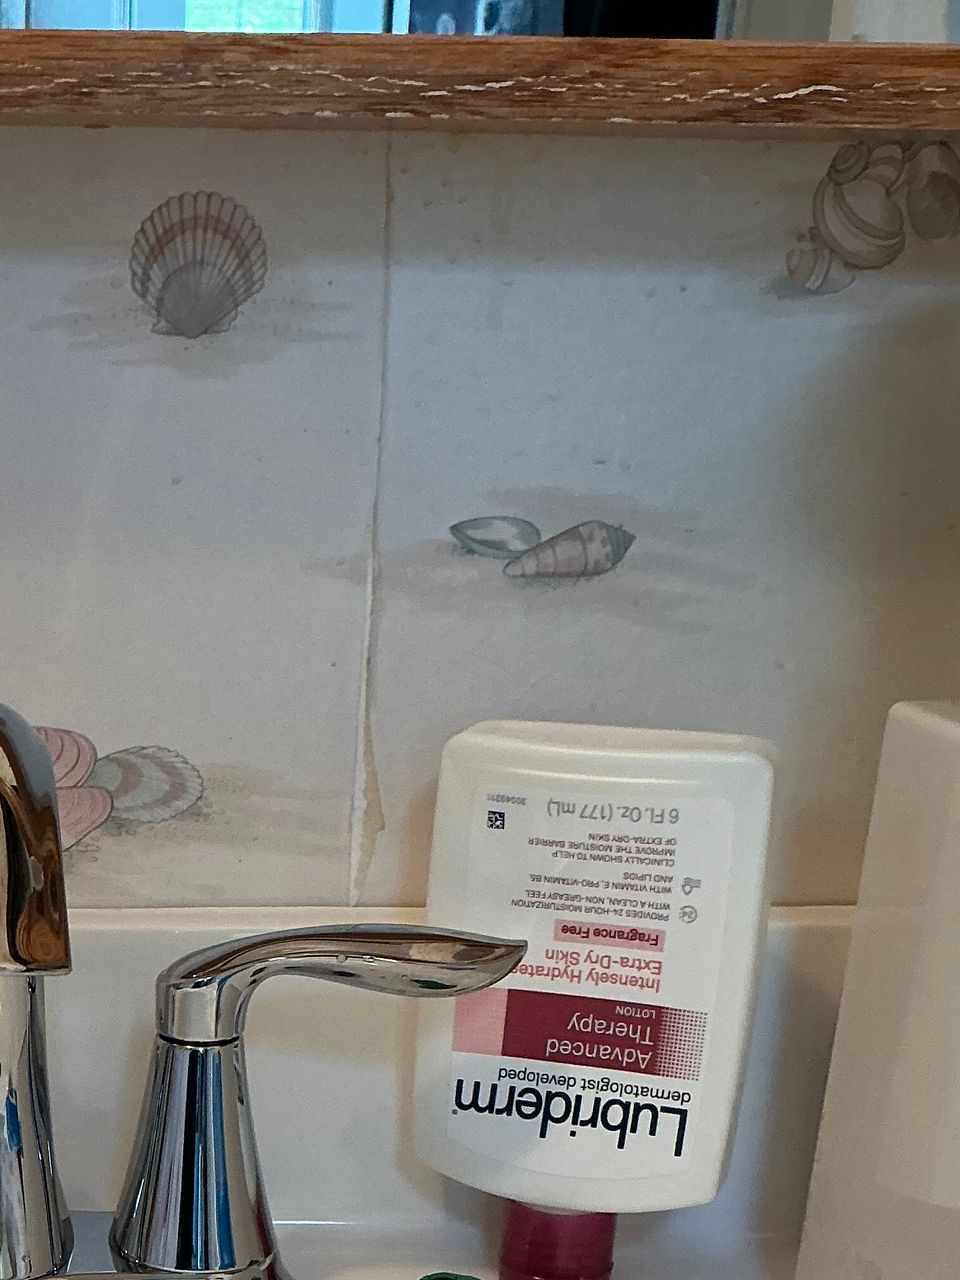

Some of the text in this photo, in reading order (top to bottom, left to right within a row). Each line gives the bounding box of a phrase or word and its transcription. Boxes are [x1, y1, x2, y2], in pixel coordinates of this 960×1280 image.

[547, 799, 679, 824] 6 Fl. Oz. (177 mL)
[528, 838, 676, 856] IMPROVE THE MOISTURE BARRIER
[588, 833, 610, 841] SKIN
[611, 835, 662, 845] EXTRA-DRY
[552, 851, 675, 867] CLINICALLY SHOWN TO HELP
[543, 876, 599, 888] PRO-VITAMIN
[612, 882, 647, 892] VITAMIN
[623, 872, 673, 883] AND LIPIDS
[649, 885, 672, 894] WITH
[511, 899, 670, 921] PROVIDES 24-HOUR MOISTURIZATION
[525, 890, 670, 910] WITH A CLEAN, NON-GREASY FEEL
[561, 924, 658, 946] Fragrance Free
[545, 949, 662, 975] Extra-Dry Skin
[584, 968, 660, 993] Intensely
[615, 1006, 656, 1018] LOTION
[567, 1012, 654, 1045] Therapy
[545, 1039, 652, 1069] Advanced
[498, 1067, 691, 1105] dermatologist developed
[454, 1080, 688, 1157] Lubriderm
